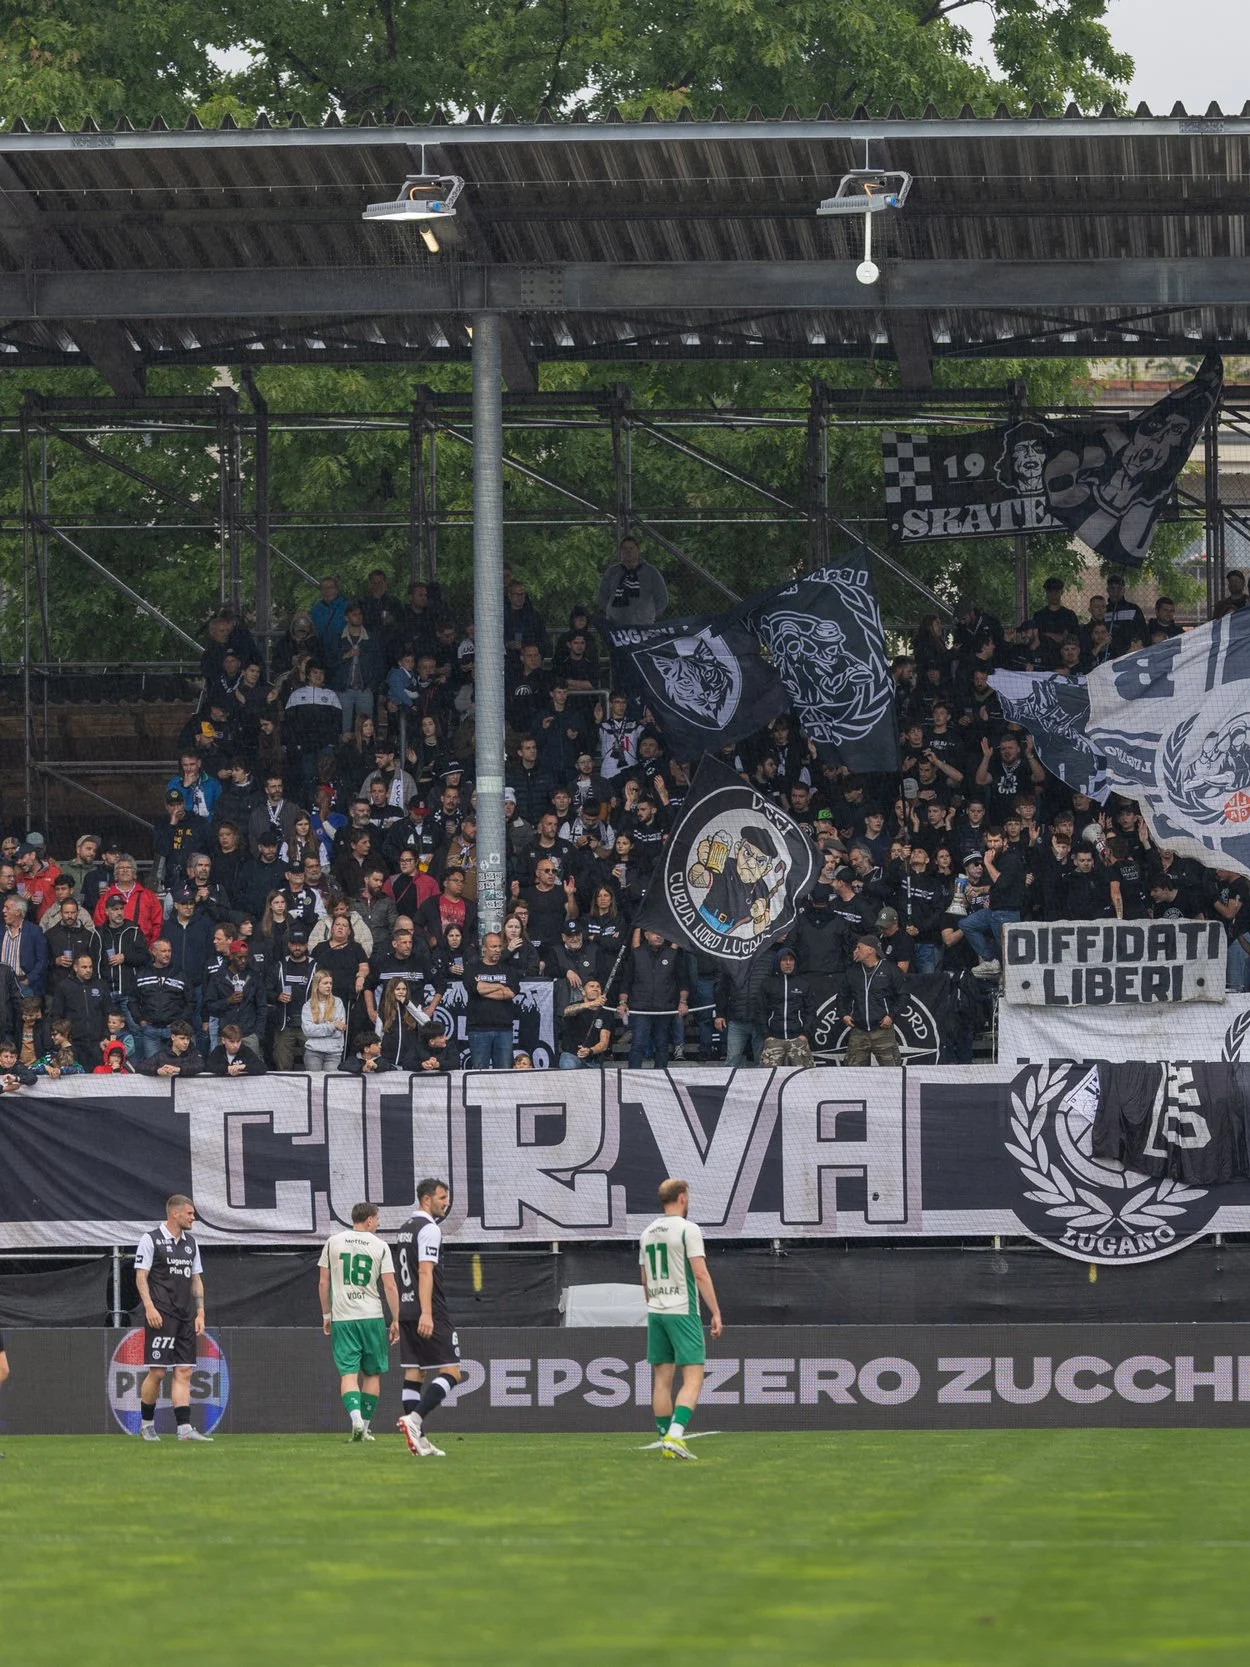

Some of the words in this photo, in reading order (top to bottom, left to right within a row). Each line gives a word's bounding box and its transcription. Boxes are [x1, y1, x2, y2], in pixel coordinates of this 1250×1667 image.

[901, 496, 1070, 540] SKATE
[669, 872, 696, 926] CURVA
[692, 923, 720, 949] NORD
[1007, 922, 1221, 966] DIFFIDATI
[1043, 965, 1184, 1005] LIBERI
[172, 1066, 910, 1232] CURVA
[344, 1238, 370, 1246] Mettler
[1058, 1225, 1176, 1256] LUGANO
[339, 1252, 373, 1287] 18
[645, 1242, 669, 1281] 11
[346, 1291, 367, 1301] VOGT
[115, 1371, 220, 1399] PSI
[440, 1357, 653, 1407] PEPSI
[700, 1357, 921, 1406] ZERO
